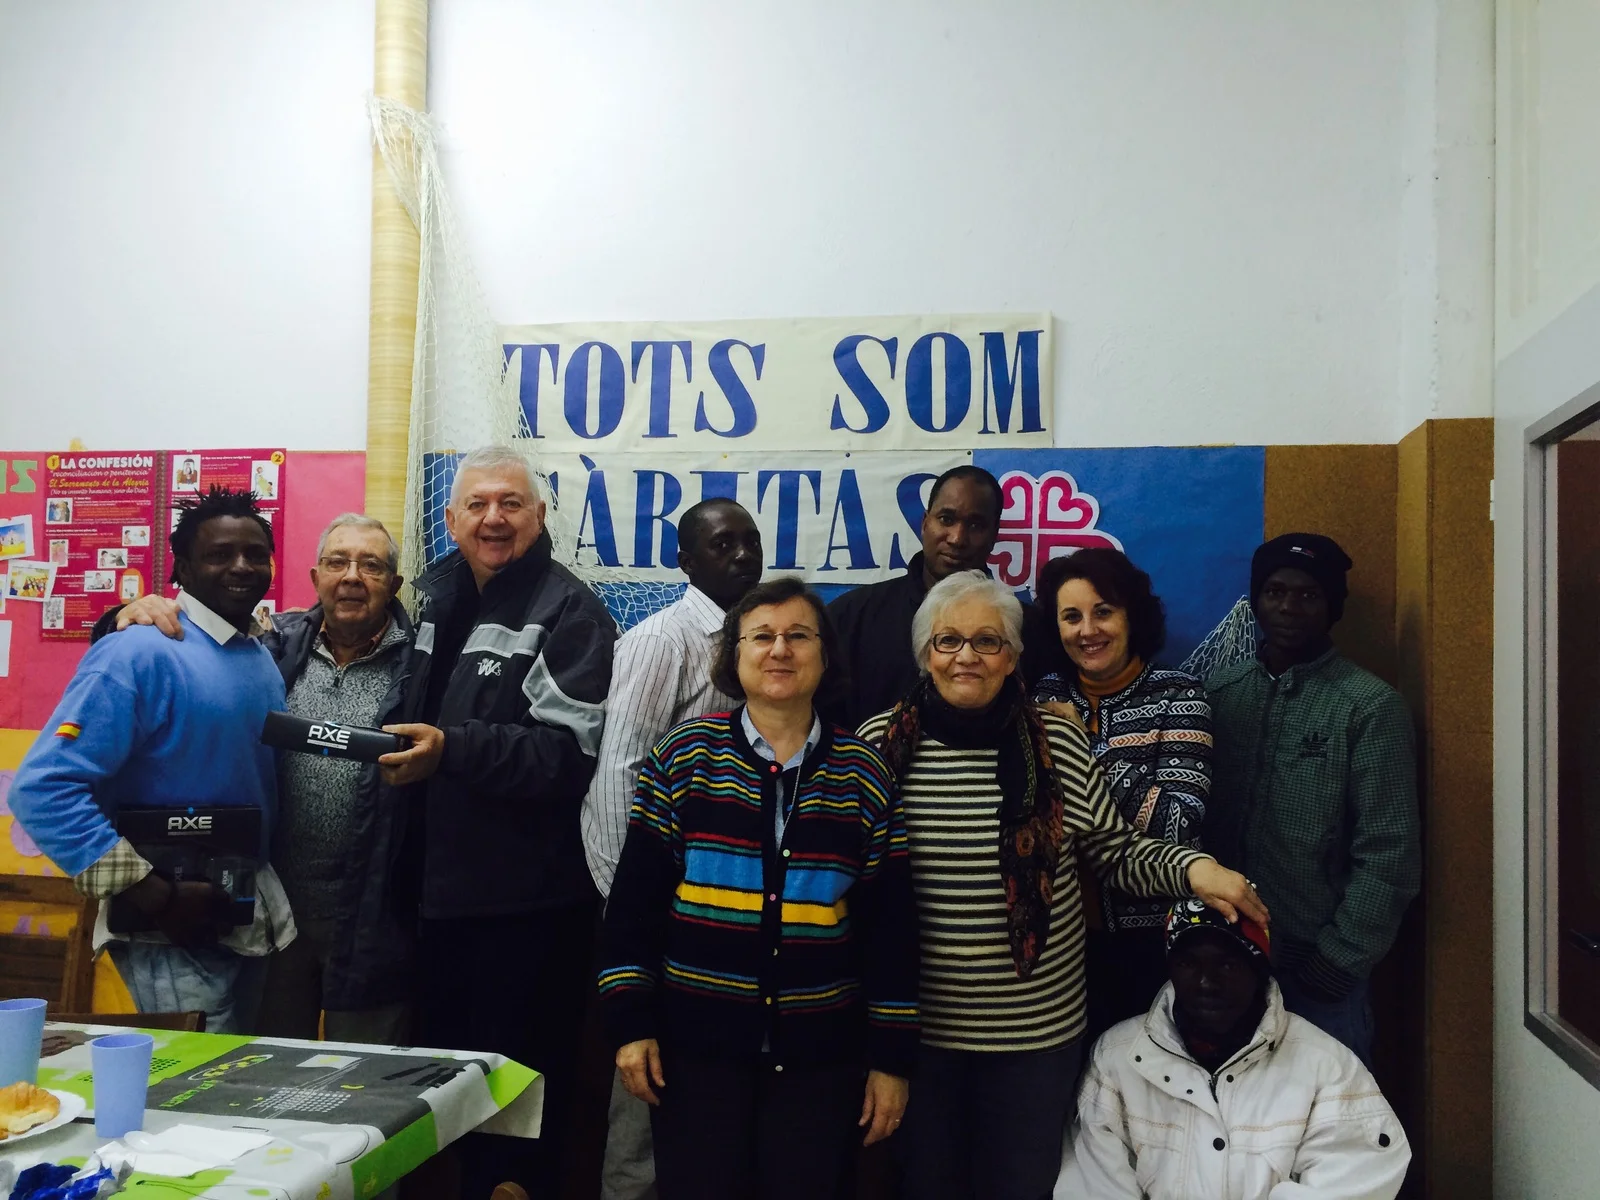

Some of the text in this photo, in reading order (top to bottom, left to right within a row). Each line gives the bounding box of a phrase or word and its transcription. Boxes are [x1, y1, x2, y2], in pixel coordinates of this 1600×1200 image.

[501, 329, 1047, 439] TOTS SOM
[60, 454, 153, 469] LA CONFESIÓN
[275, 454, 281, 462] 2
[308, 725, 351, 744] AXE
[167, 816, 213, 830] AXE
